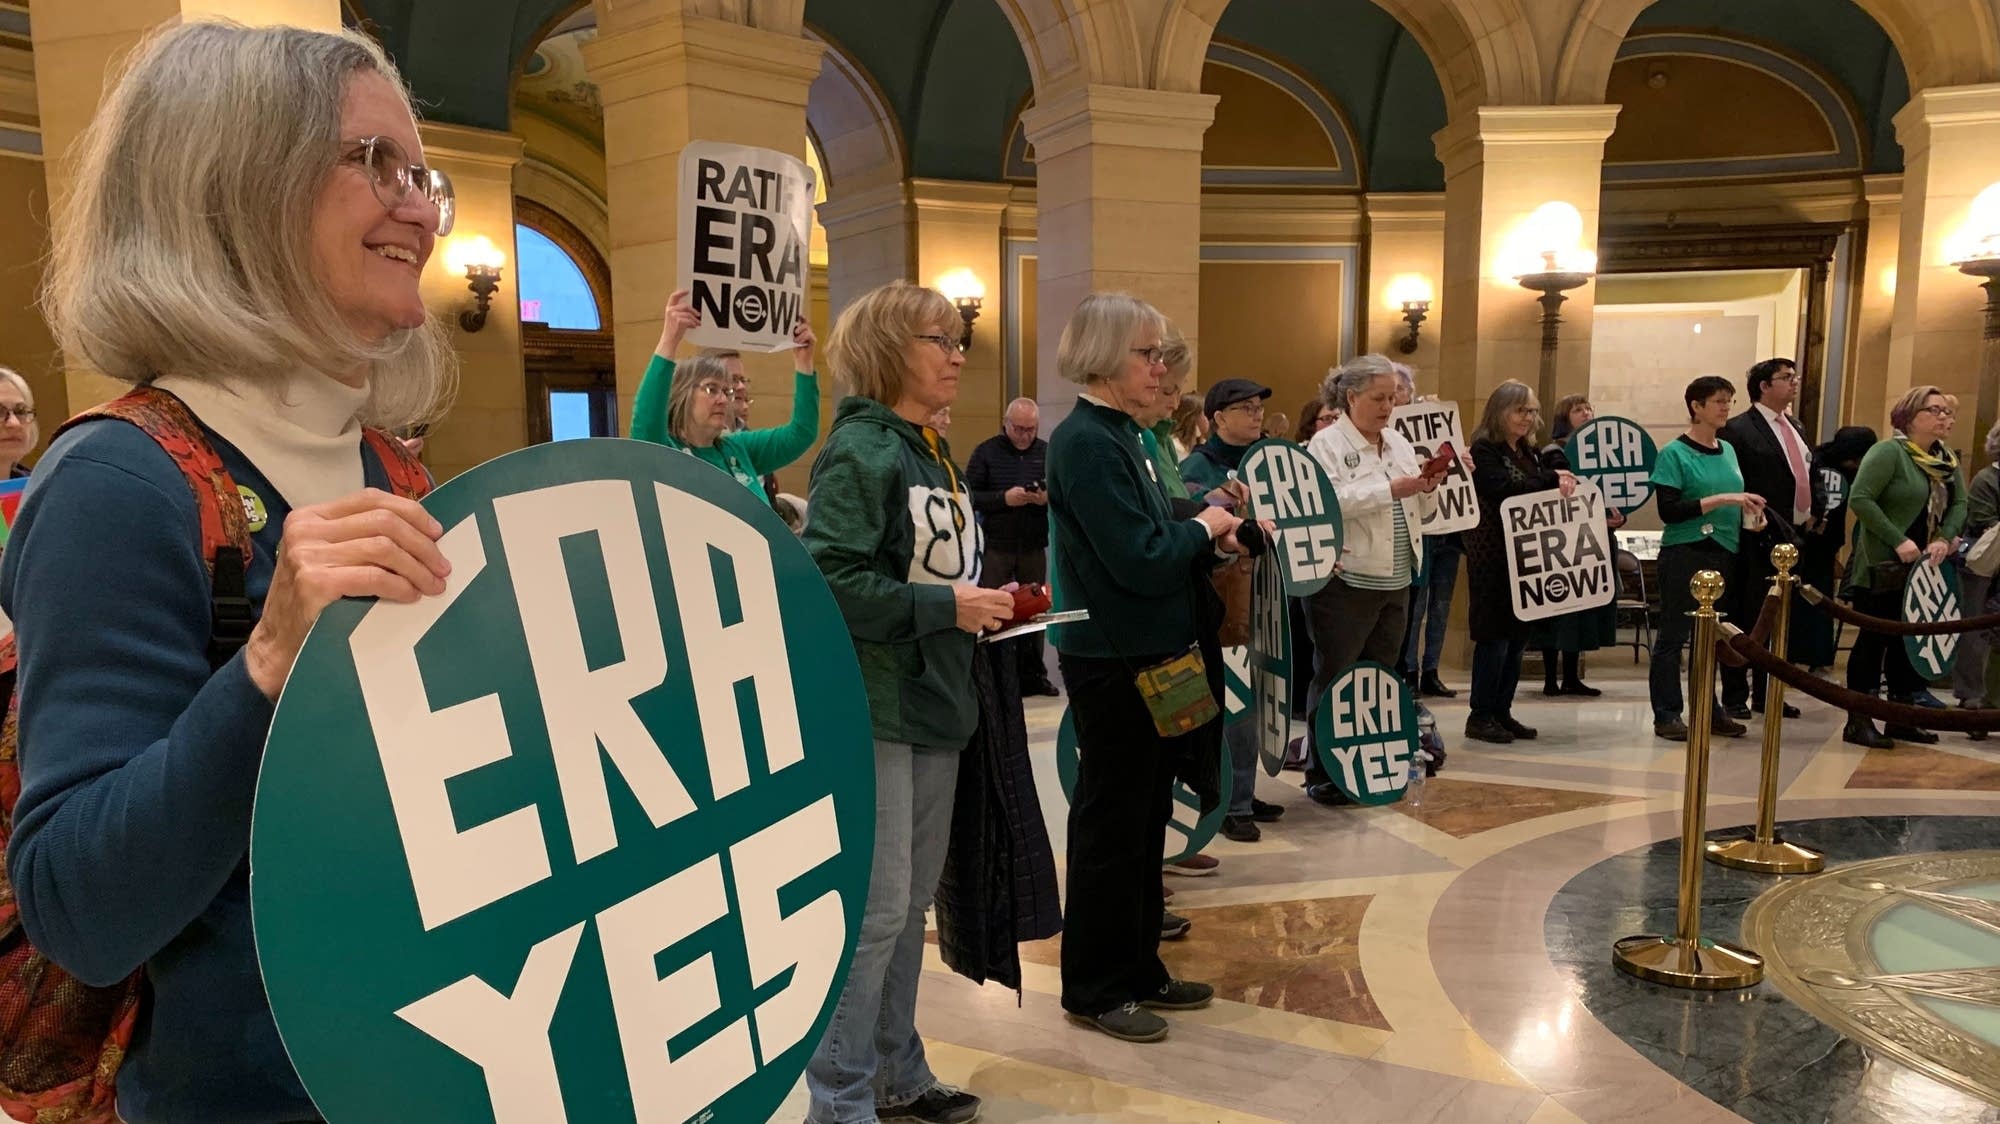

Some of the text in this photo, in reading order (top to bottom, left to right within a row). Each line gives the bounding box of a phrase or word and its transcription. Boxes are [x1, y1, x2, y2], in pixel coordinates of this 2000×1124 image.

[693, 205, 802, 289] ERA
[1395, 410, 1454, 444] ATIFY
[1577, 420, 1643, 470] ERA
[1245, 445, 1325, 521] ERA
[1508, 492, 1597, 533] RATIFY
[1513, 522, 1606, 577] ERA
[1518, 564, 1609, 609] NOW!
[349, 479, 805, 931] ERA
[1331, 667, 1402, 739] ERA
[1330, 739, 1410, 798] YES
[393, 793, 846, 1124] YES
